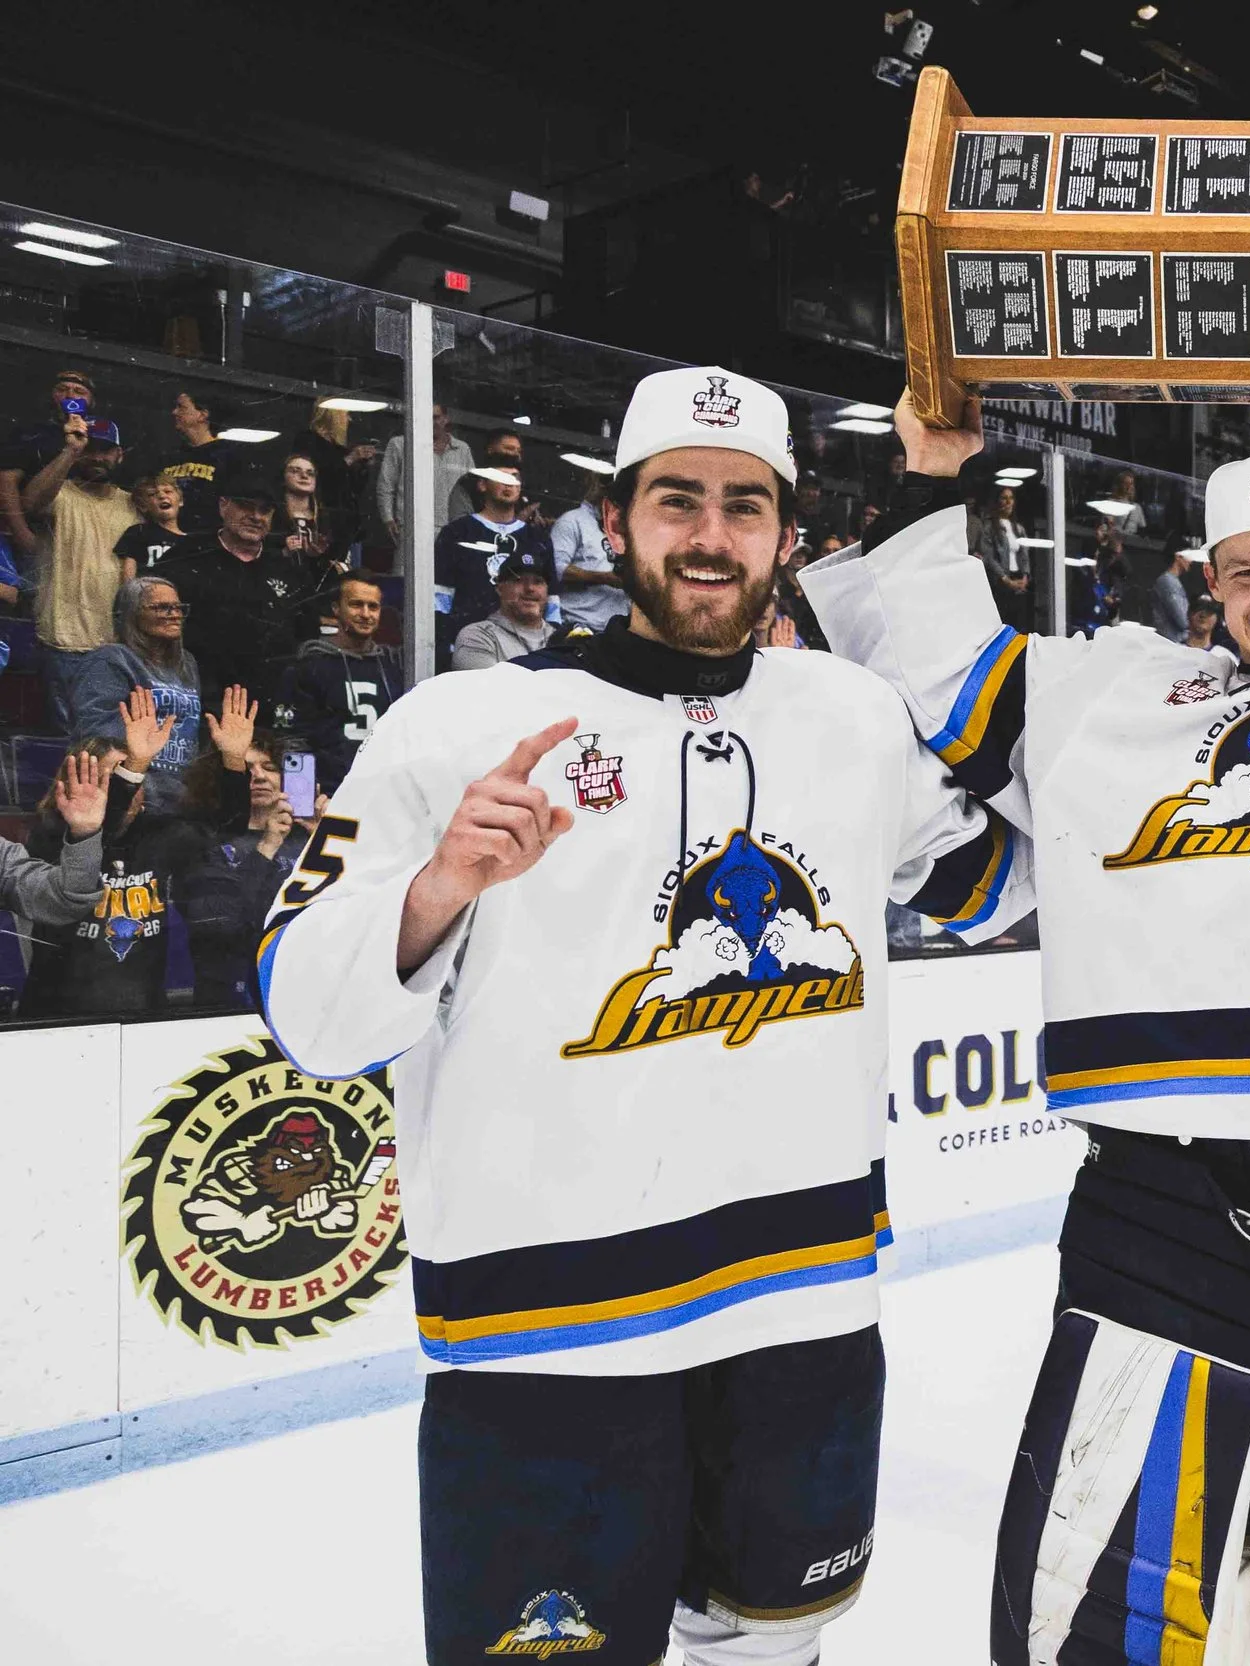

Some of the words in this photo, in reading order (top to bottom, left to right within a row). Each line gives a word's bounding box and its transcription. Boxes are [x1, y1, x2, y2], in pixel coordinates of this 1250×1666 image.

[694, 392, 740, 407] CLARK
[703, 402, 730, 413] CUP
[344, 681, 377, 740] 5
[686, 703, 712, 711] USHL
[566, 756, 622, 779] CLARK
[578, 771, 614, 790] CUP
[588, 786, 611, 799] FINAL
[283, 815, 360, 907] 5
[126, 870, 153, 887] CUP
[653, 835, 722, 923] SIOUX
[761, 832, 831, 906] FALLS
[939, 1125, 1010, 1152] COFFEE
[173, 1178, 400, 1310] LUMBERJACKS
